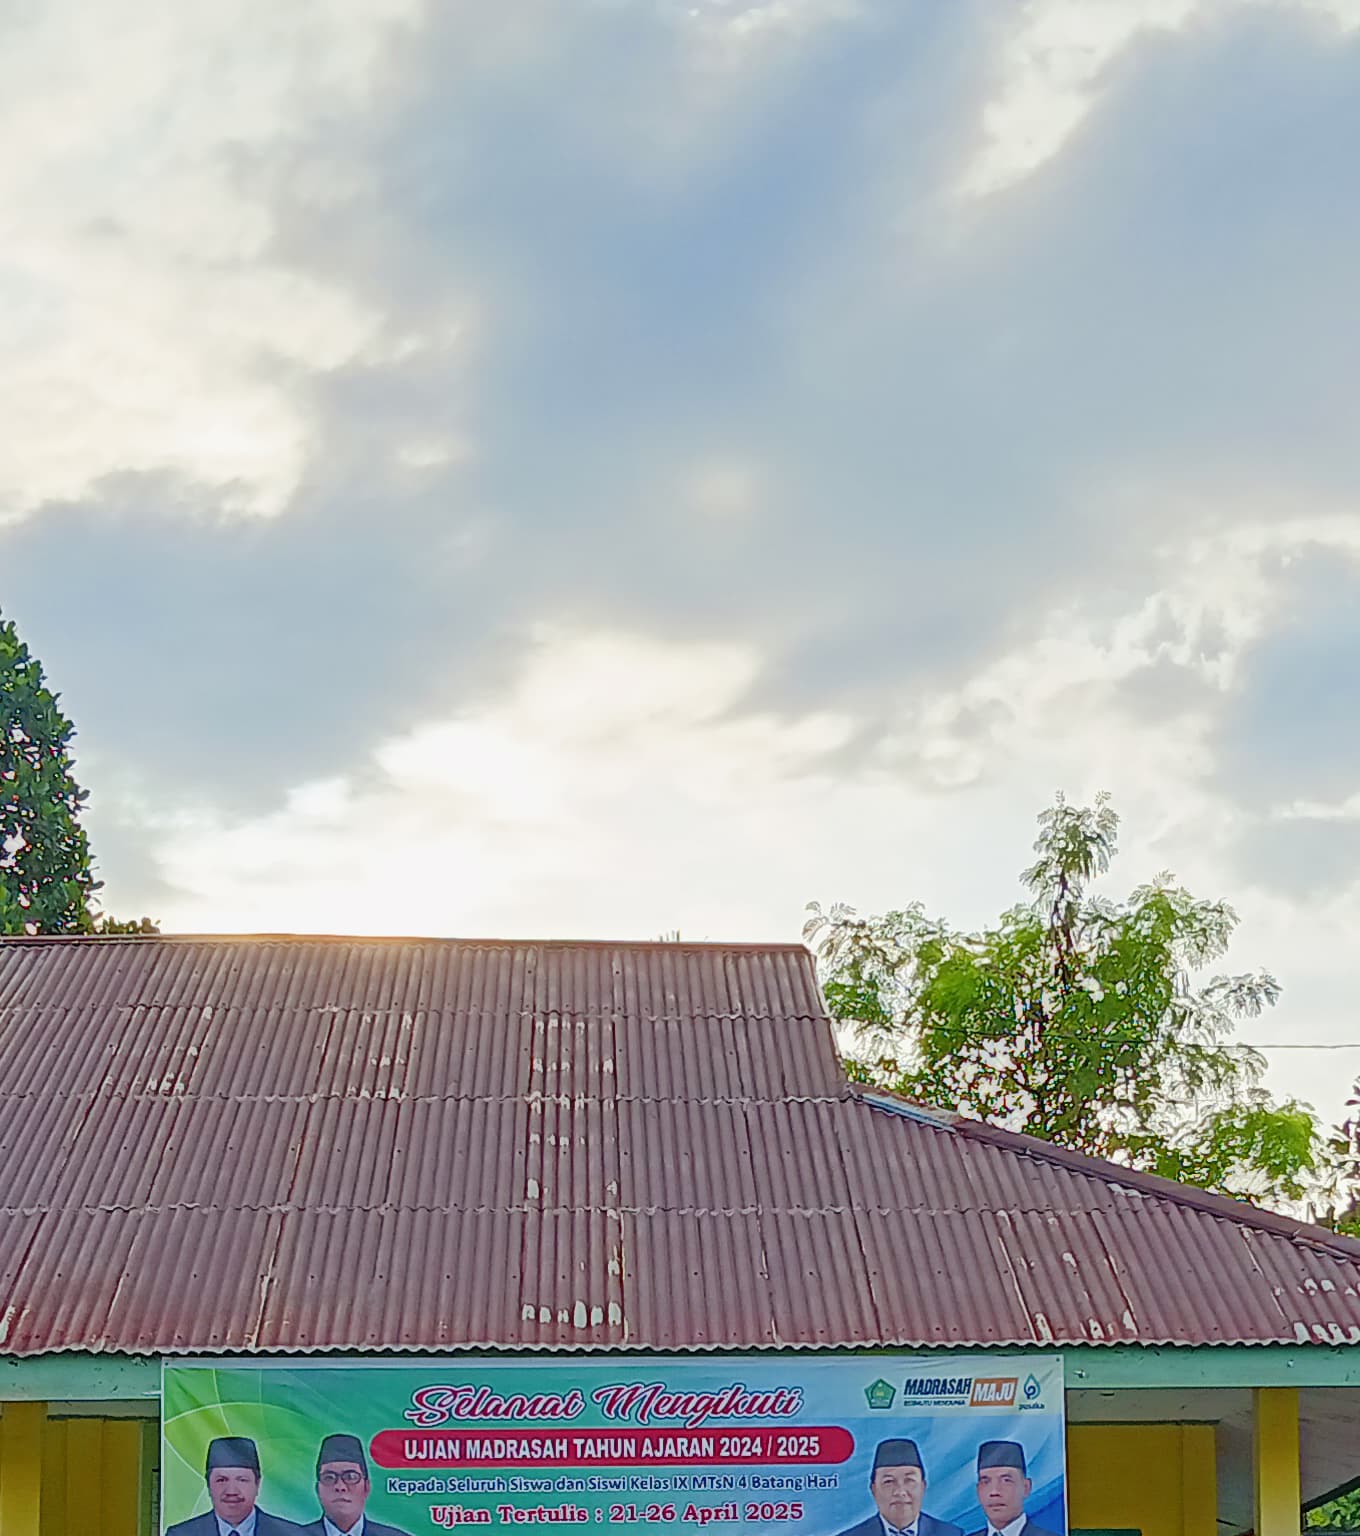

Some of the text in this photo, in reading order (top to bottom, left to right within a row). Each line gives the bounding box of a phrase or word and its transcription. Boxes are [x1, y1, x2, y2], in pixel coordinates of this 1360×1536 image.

[904, 1378, 1015, 1402] MADRASAH MAJU
[404, 1383, 804, 1428] Selamat Mengikuti
[404, 1436, 820, 1460] UJIAN MADRASAH TAHUN AJARAN 2024 / 2025
[388, 1475, 838, 1495] Kepada Seluruh Siswa dan Siswi Kelas IX MTsN 4 Batang Hari
[430, 1502, 804, 1528] Ujian Tertulis : 21-26 April 2025
